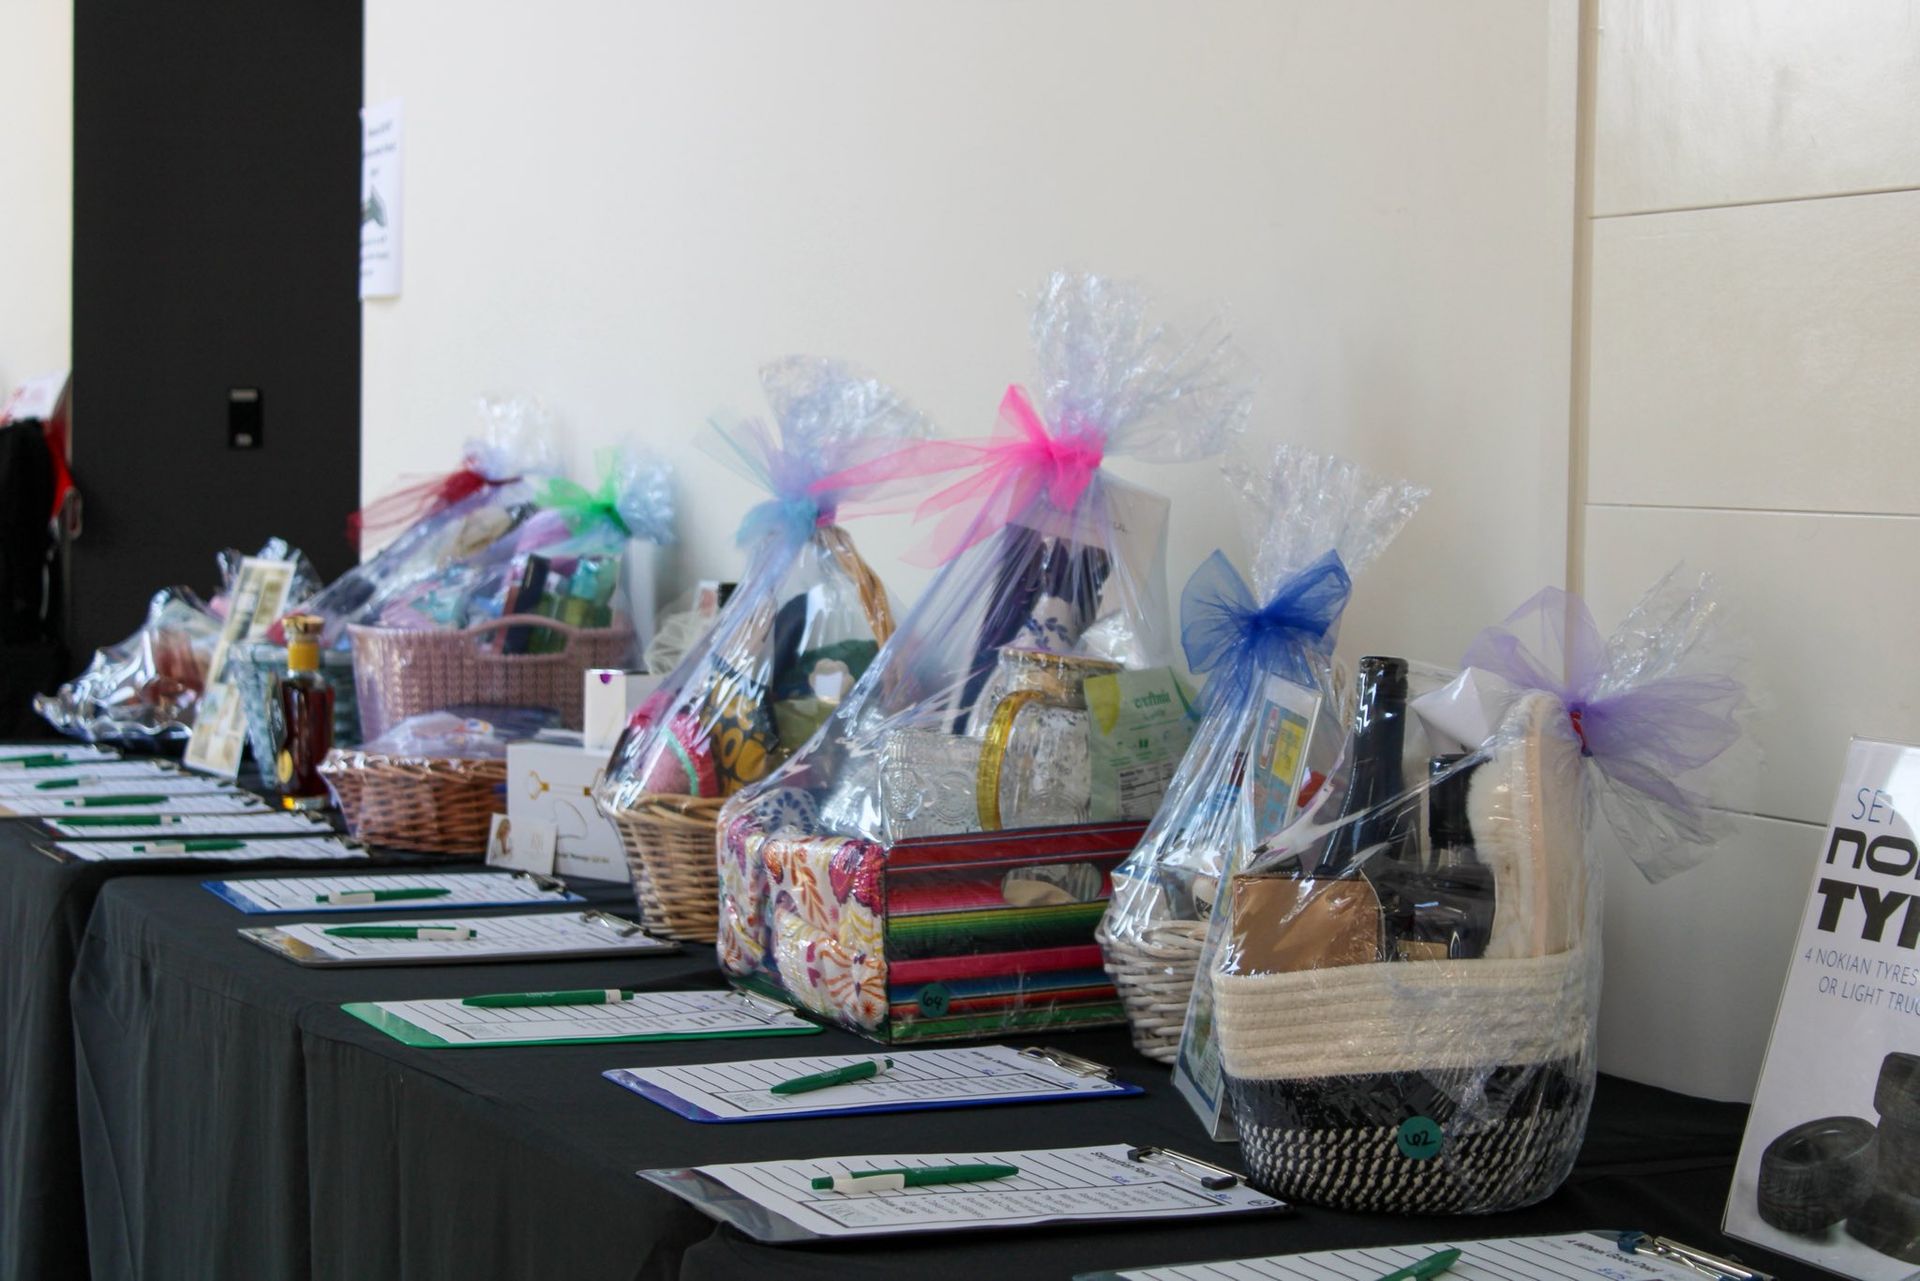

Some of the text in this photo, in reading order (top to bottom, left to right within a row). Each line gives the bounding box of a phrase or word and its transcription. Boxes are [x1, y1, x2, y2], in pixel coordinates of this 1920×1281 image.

[1825, 827, 1920, 880] no
[1804, 948, 1919, 986] 4 NOKIAN TYRES
[1818, 976, 1838, 996] OR
[1841, 981, 1884, 1006] LIGHT
